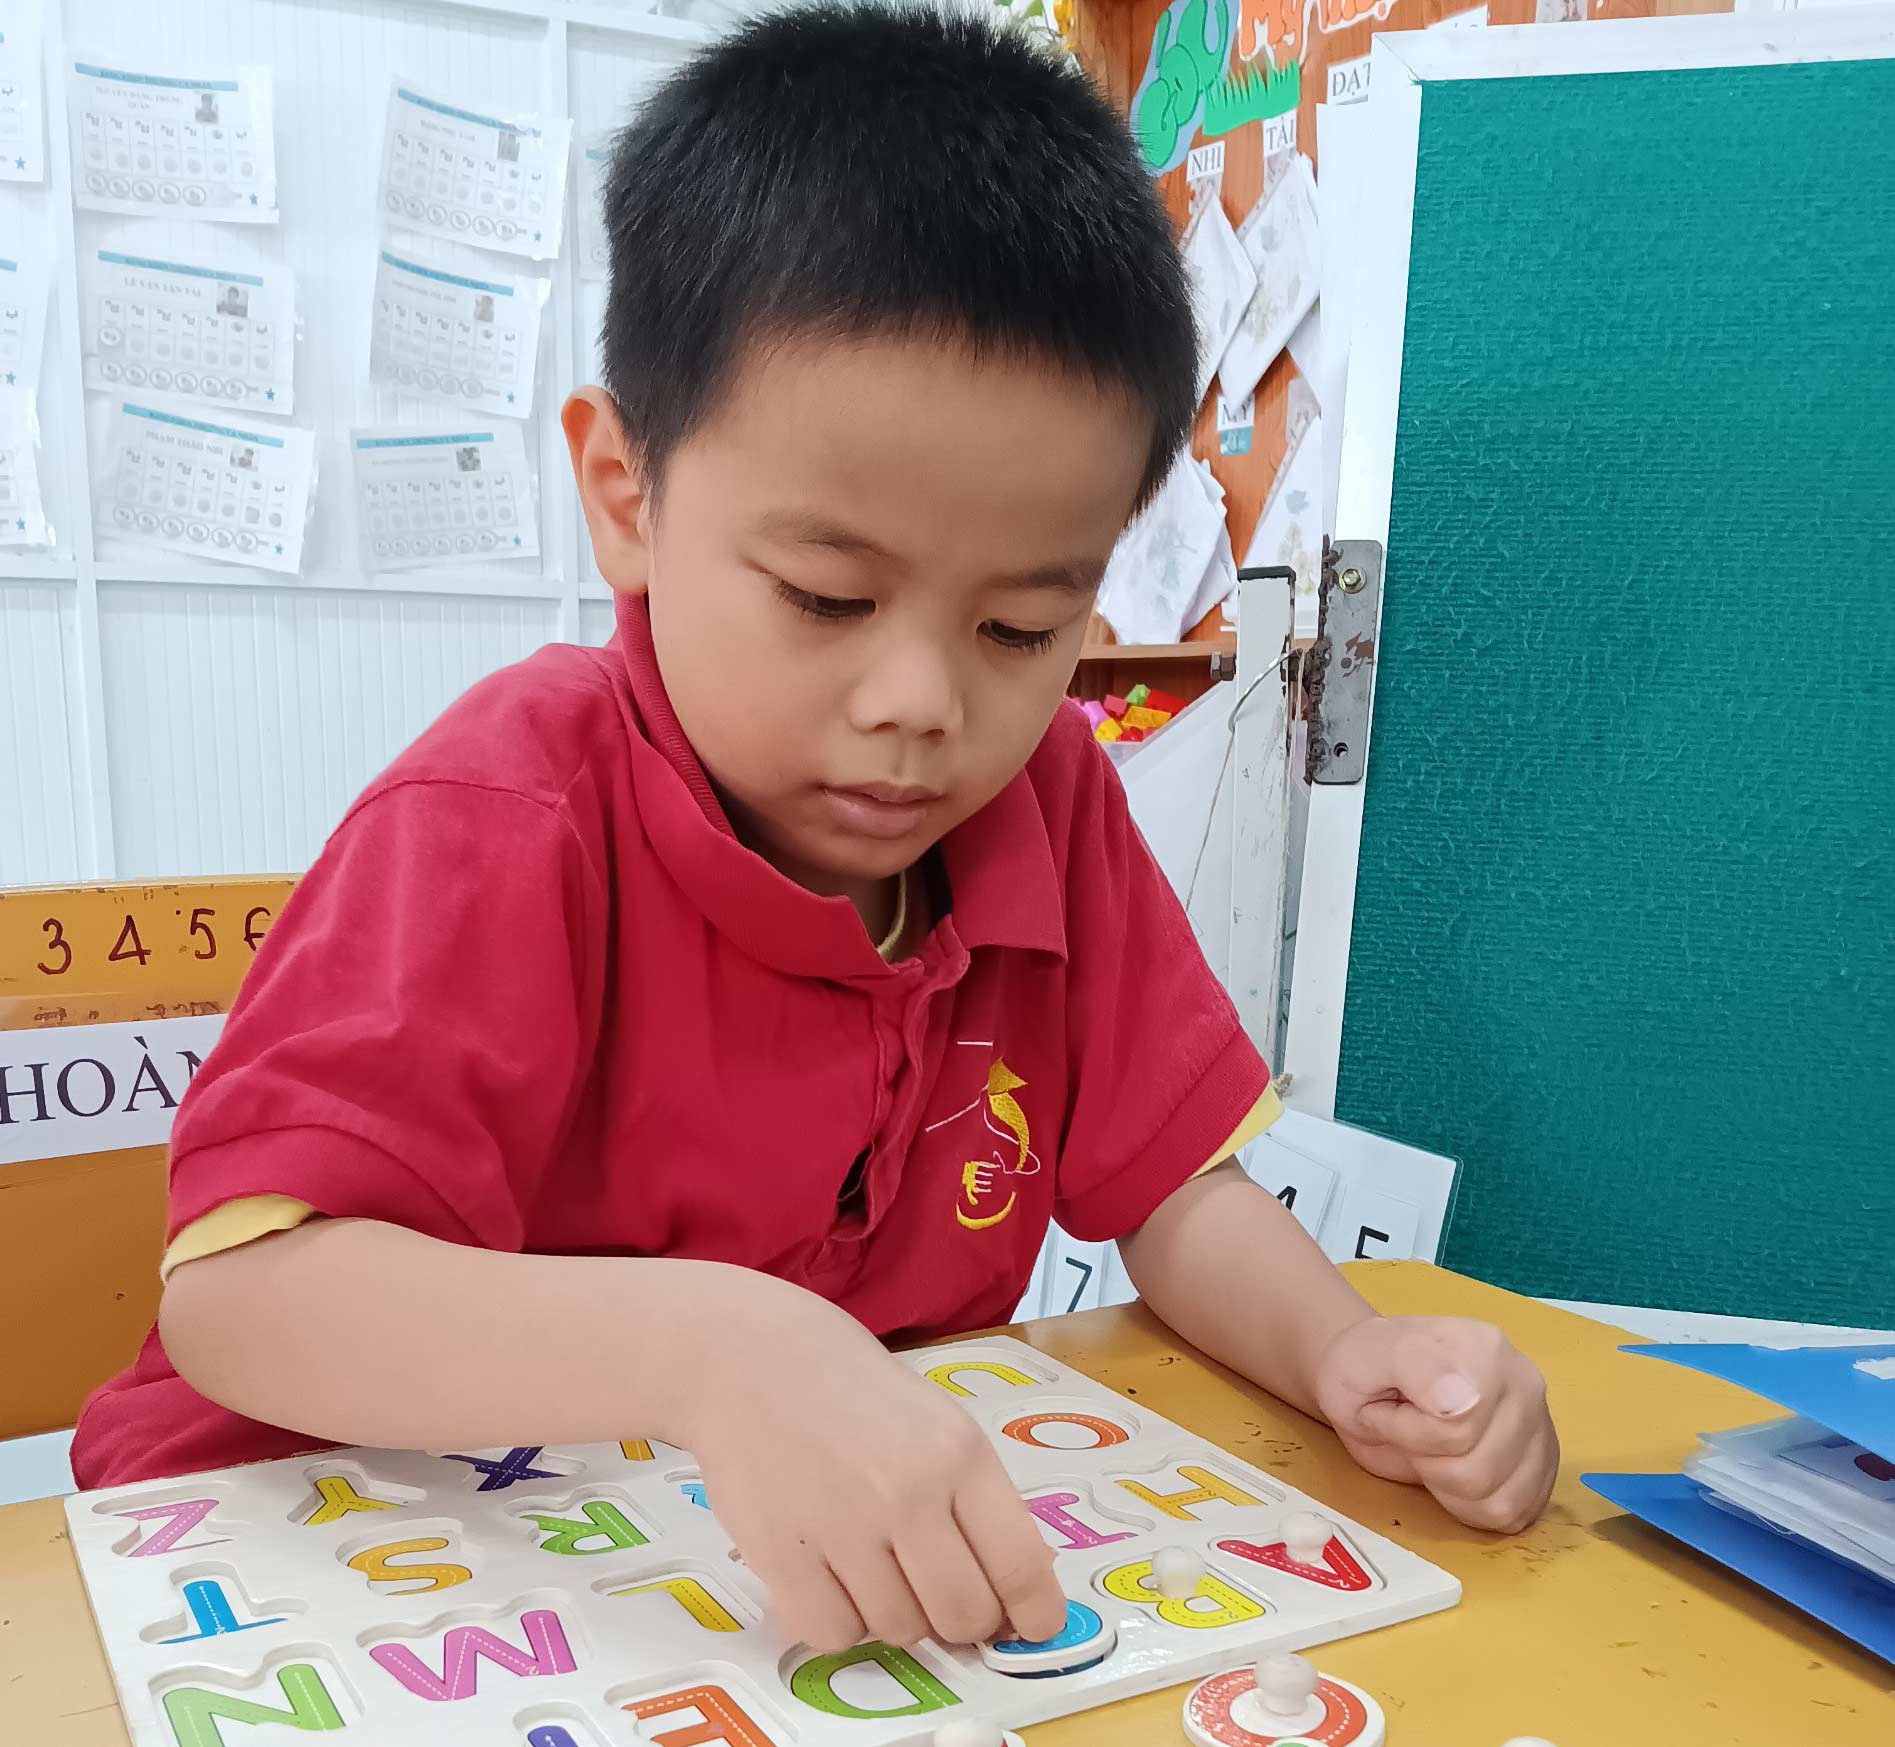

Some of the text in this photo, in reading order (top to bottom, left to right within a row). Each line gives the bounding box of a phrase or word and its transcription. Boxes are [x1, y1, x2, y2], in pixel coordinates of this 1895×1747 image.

[1191, 145, 1222, 176] NHI
[37, 917, 72, 975] 3
[108, 915, 152, 965] 4
[190, 908, 217, 960] 5
